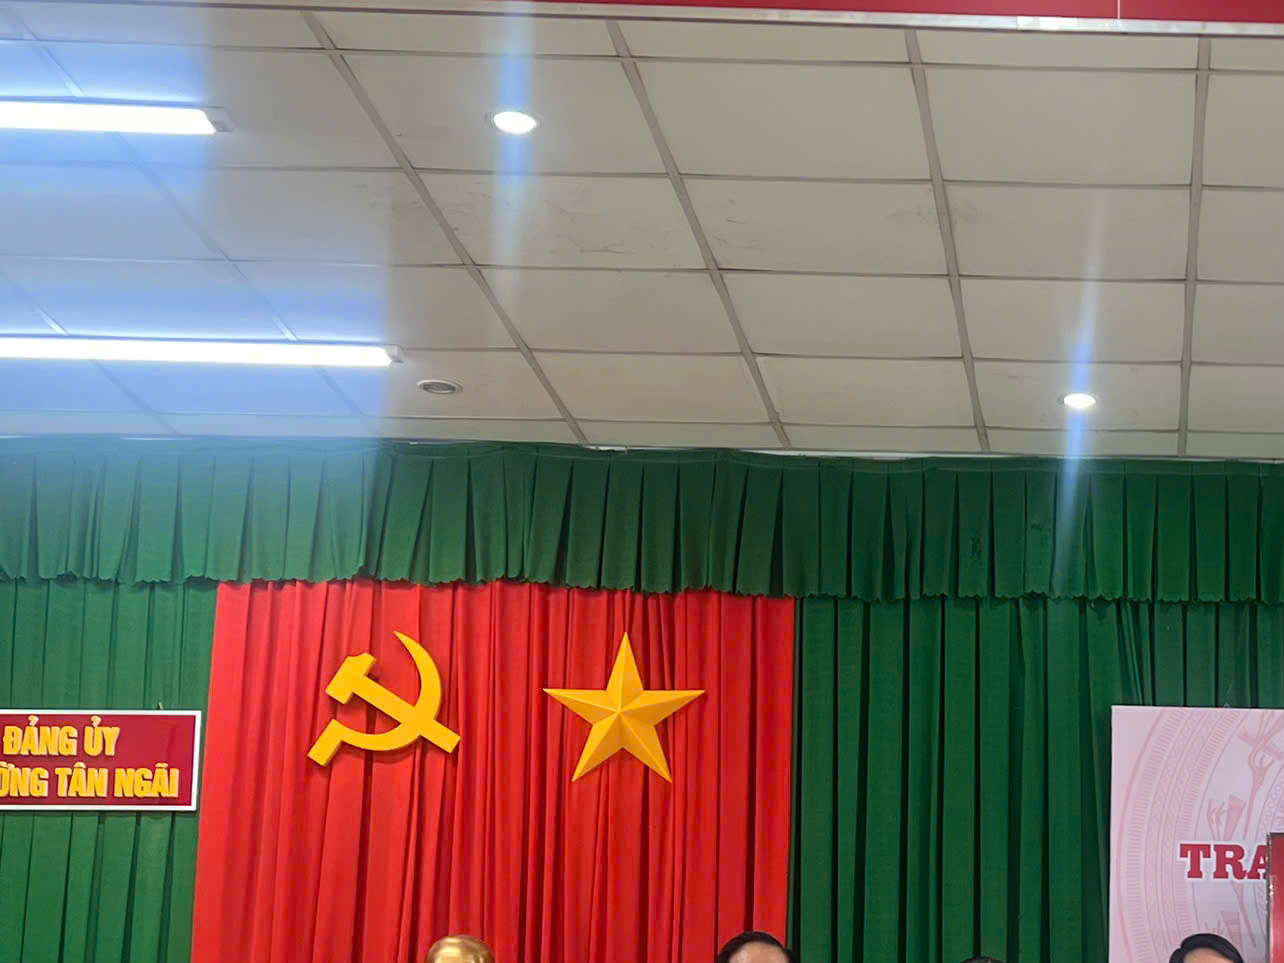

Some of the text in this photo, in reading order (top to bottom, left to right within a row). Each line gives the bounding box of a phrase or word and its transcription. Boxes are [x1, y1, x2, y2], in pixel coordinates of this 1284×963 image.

[3, 715, 120, 756] ĐẢNG ỦY
[55, 761, 108, 798] TÂN
[114, 762, 180, 798] NGÃI
[1180, 843, 1267, 880] TRA
